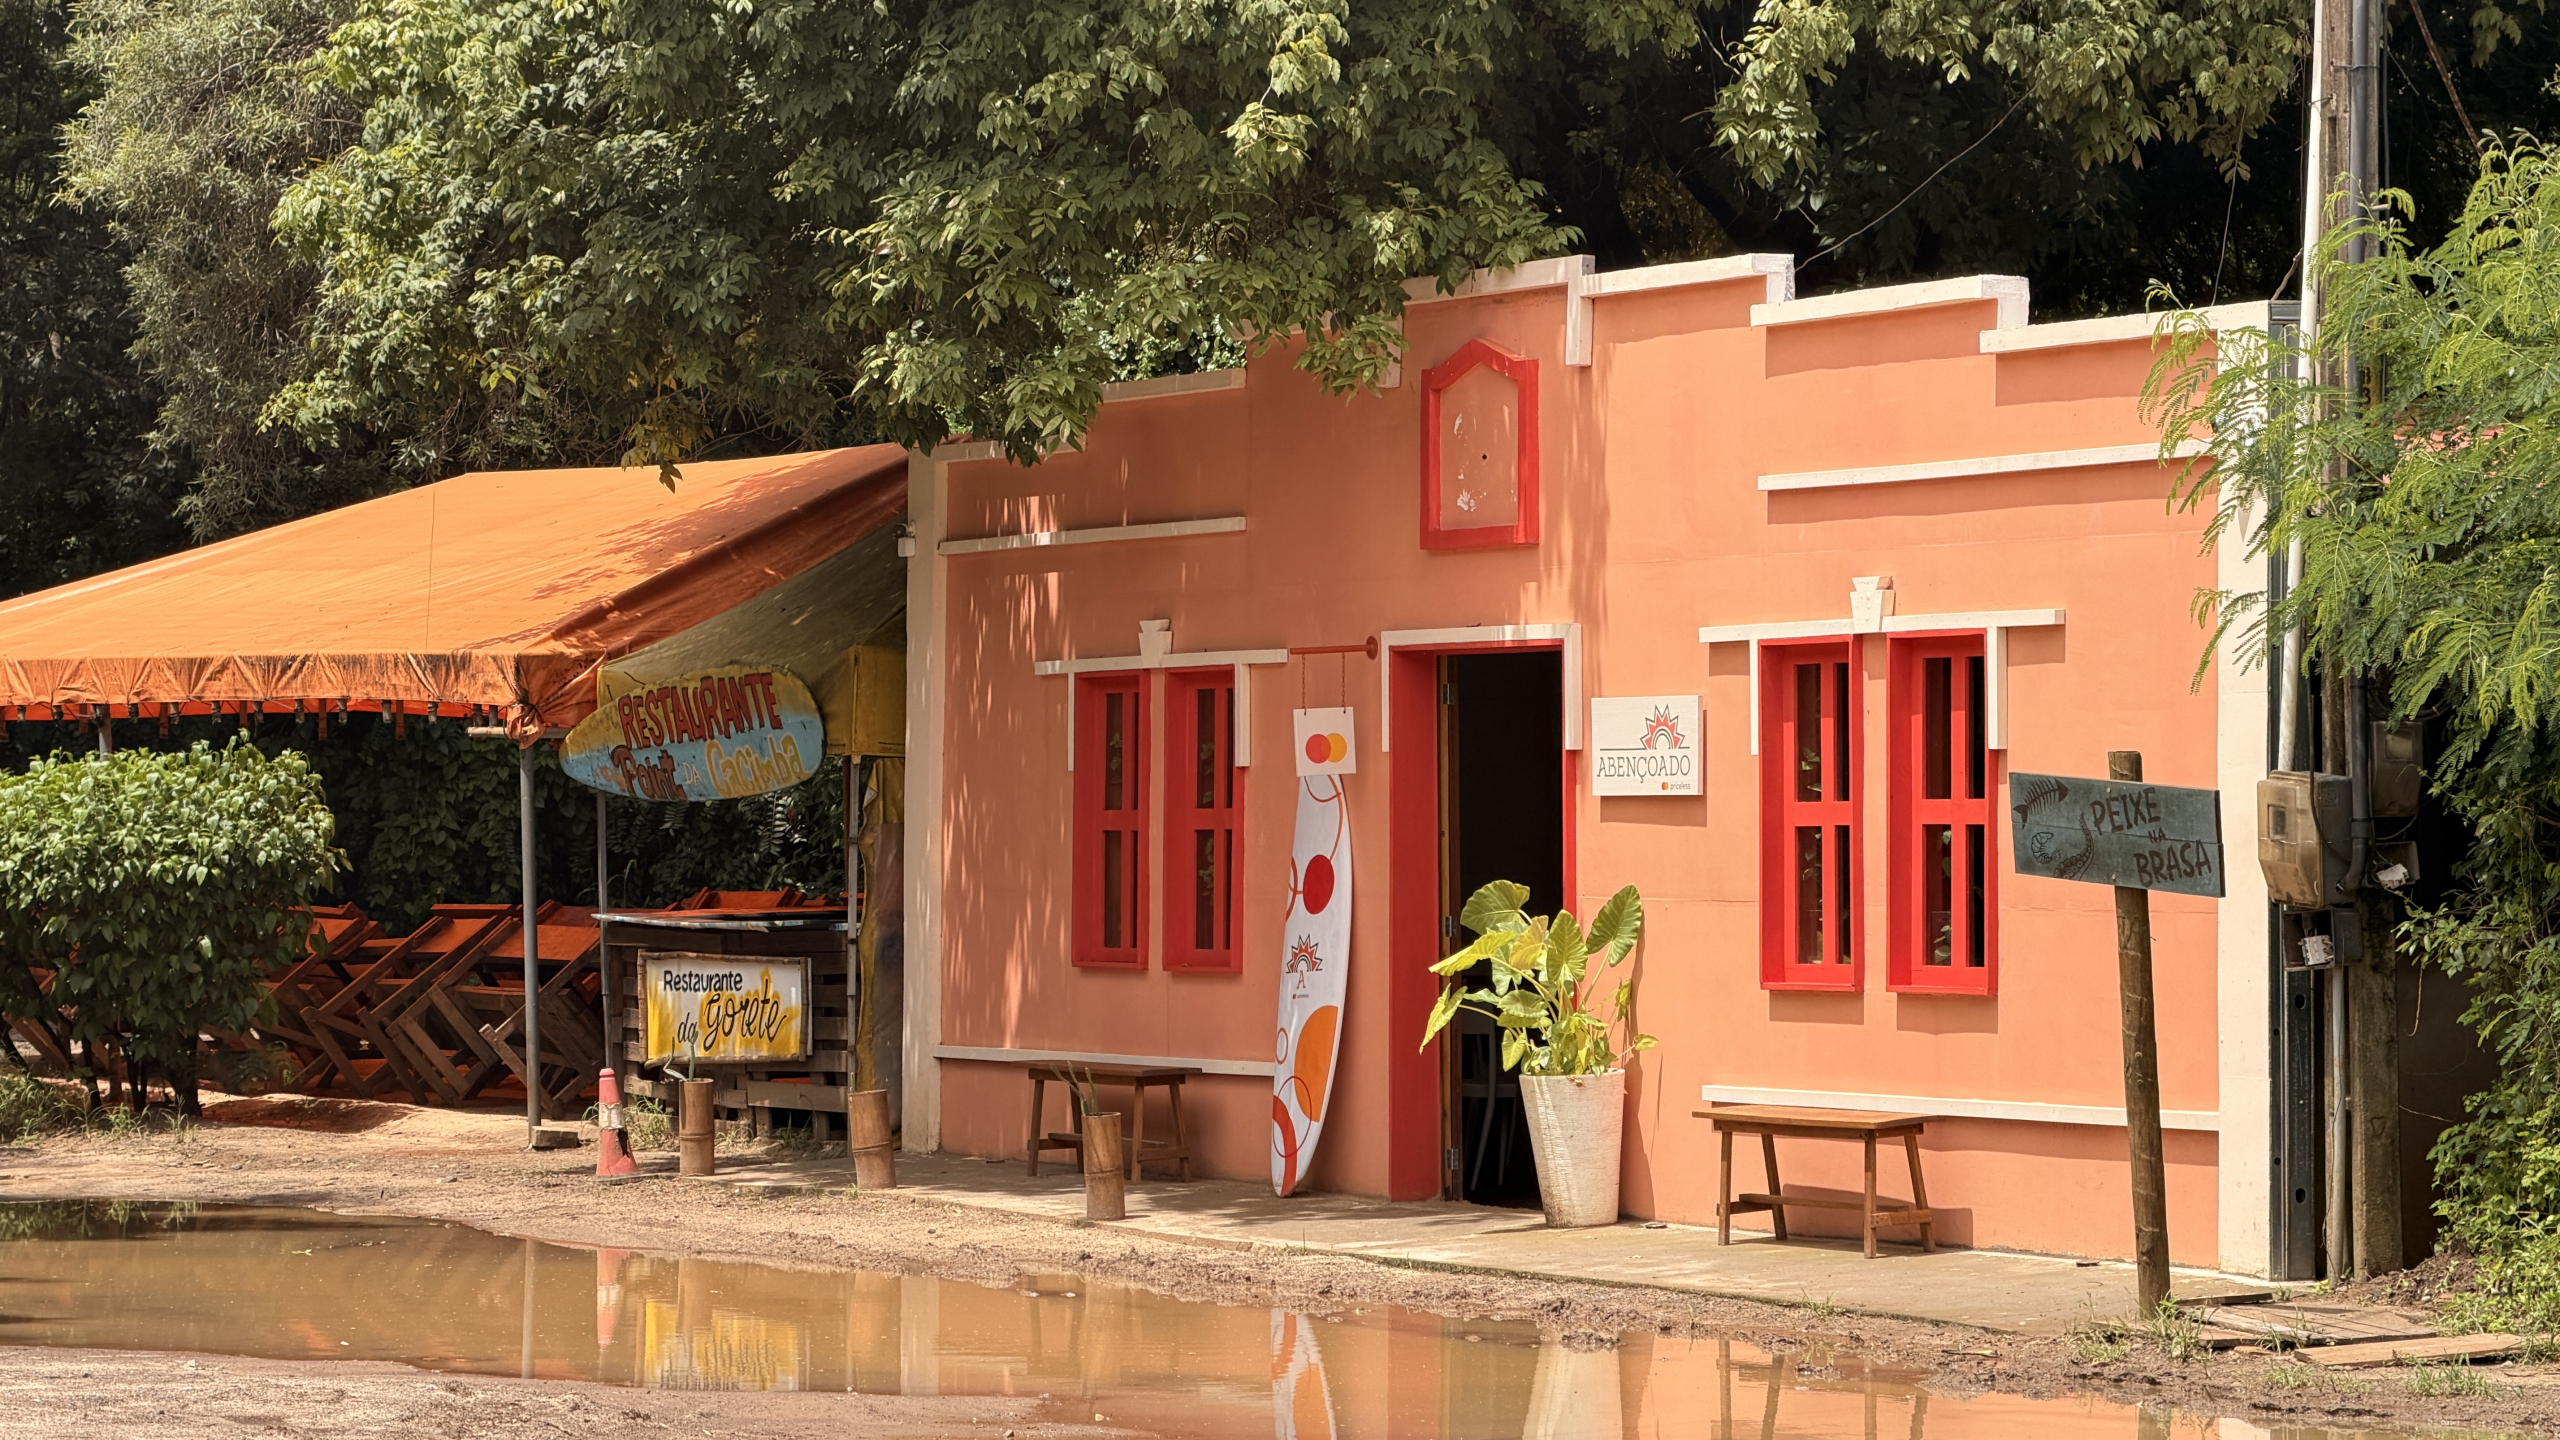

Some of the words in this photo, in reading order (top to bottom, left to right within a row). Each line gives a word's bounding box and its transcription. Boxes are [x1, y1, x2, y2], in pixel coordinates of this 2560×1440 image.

[618, 673, 783, 749] RESTAURANTE
[611, 745, 688, 800] Point
[682, 762, 702, 786] DA
[705, 732, 811, 799] Cacimba
[1597, 755, 1691, 783] ABENÇOADO
[1670, 782, 1690, 790] priceless
[2090, 787, 2161, 836] PEIXE
[2148, 827, 2166, 844] NA
[2133, 839, 2212, 887] BRASA
[664, 970, 743, 992] Restaurante
[1296, 970, 1306, 989] A
[678, 1012, 698, 1044] da
